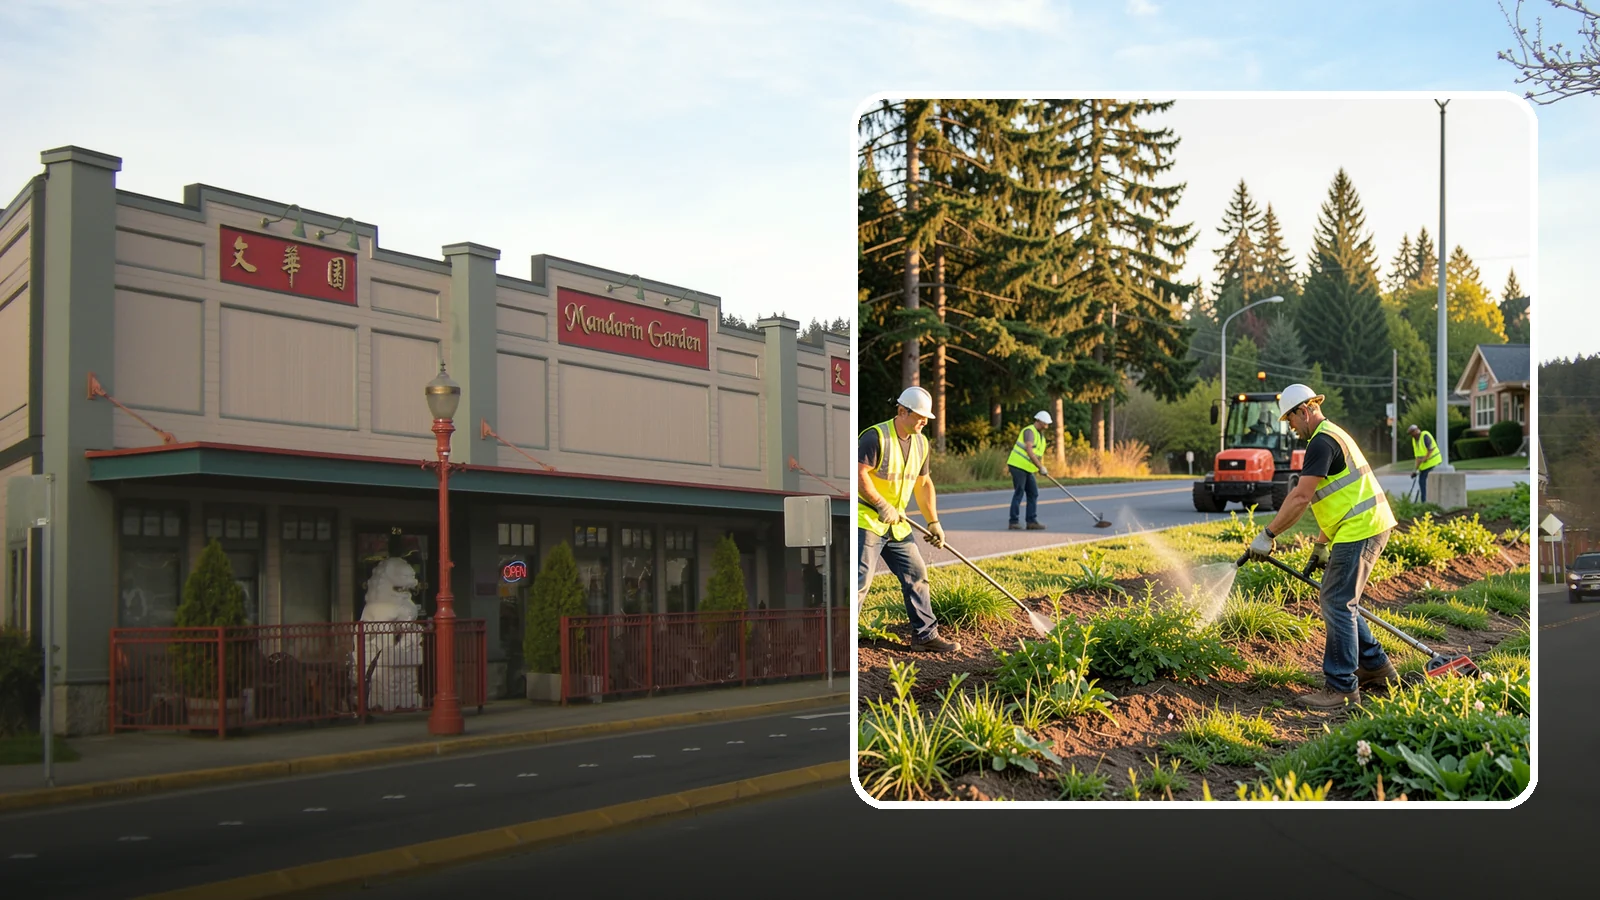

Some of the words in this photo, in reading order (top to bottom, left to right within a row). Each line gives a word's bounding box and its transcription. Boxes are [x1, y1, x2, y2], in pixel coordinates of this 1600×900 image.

[231, 235, 346, 291] 文華園
[564, 302, 644, 341] Mandarin
[648, 320, 702, 352] Garden
[503, 565, 527, 578] OPEN
